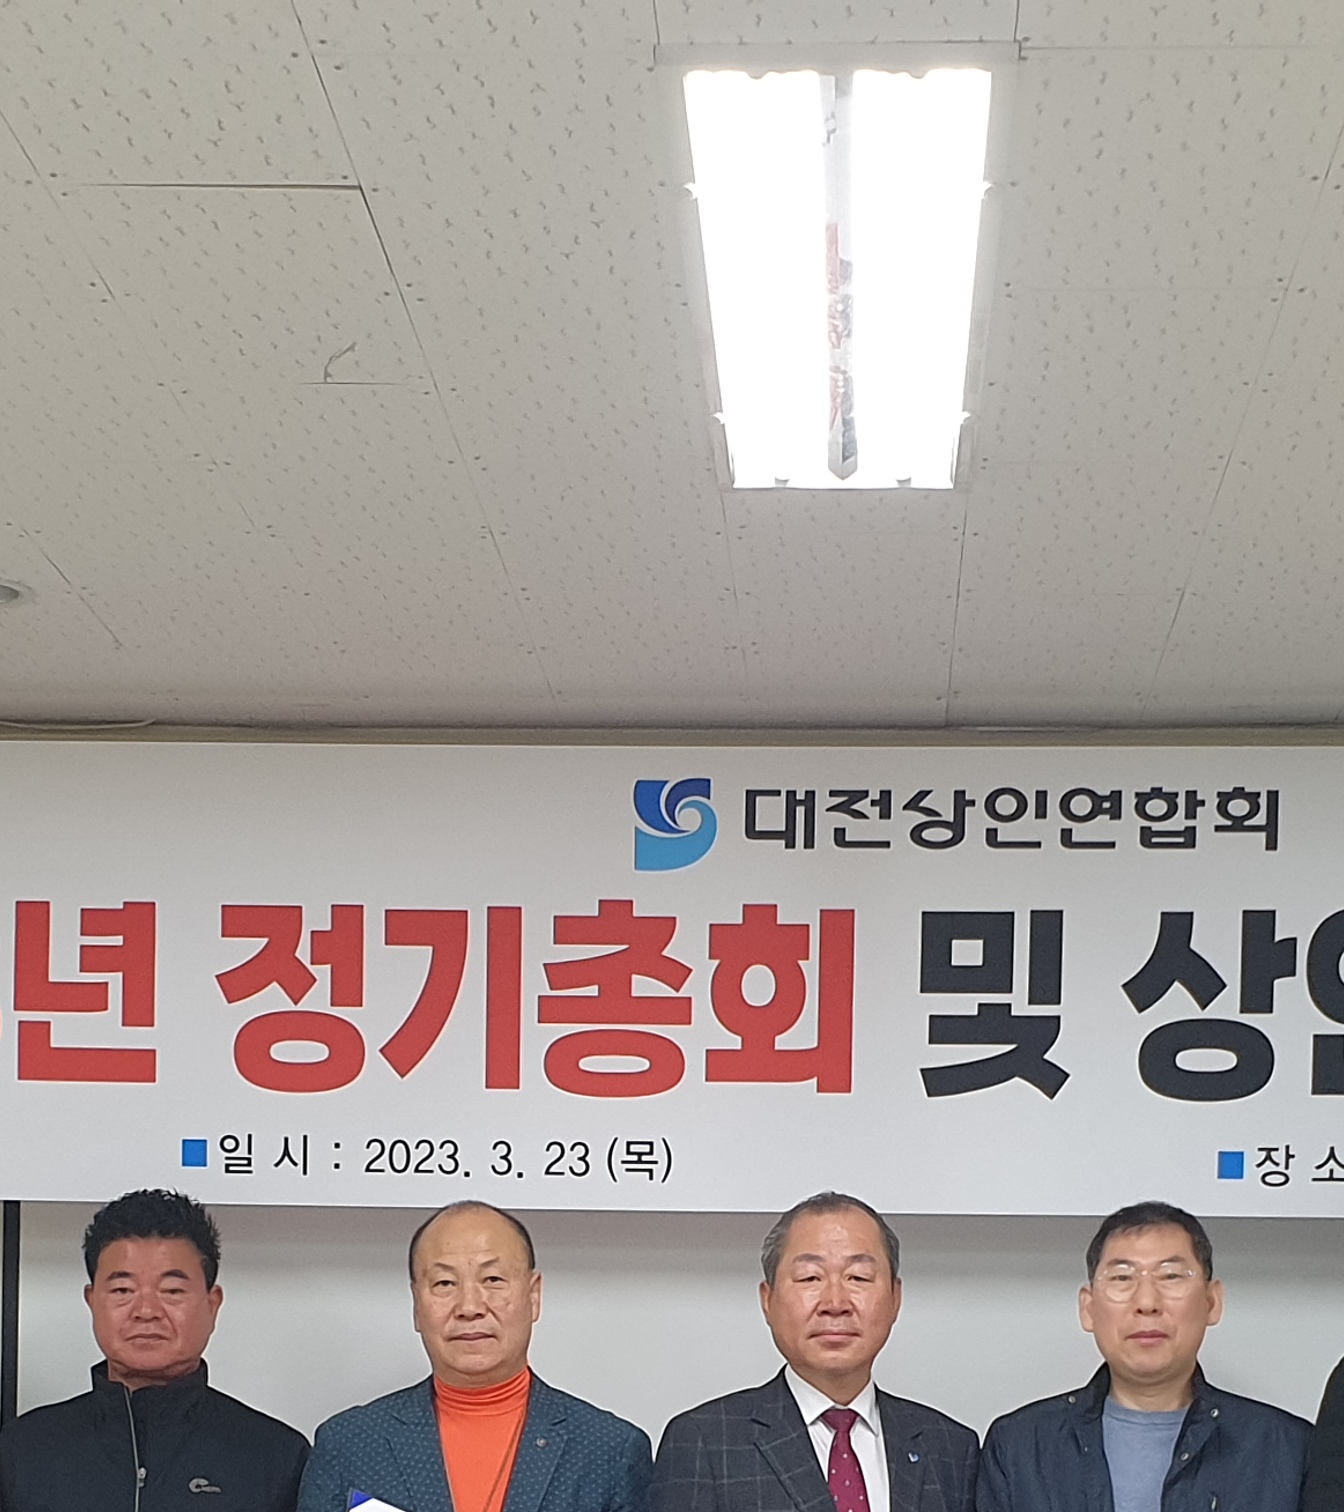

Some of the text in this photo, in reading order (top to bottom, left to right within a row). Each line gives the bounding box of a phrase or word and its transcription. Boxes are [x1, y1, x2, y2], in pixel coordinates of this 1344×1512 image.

[744, 786, 1280, 852] 대전상인연합회
[214, 899, 856, 1098] 정기총회
[919, 909, 1071, 1100] 및
